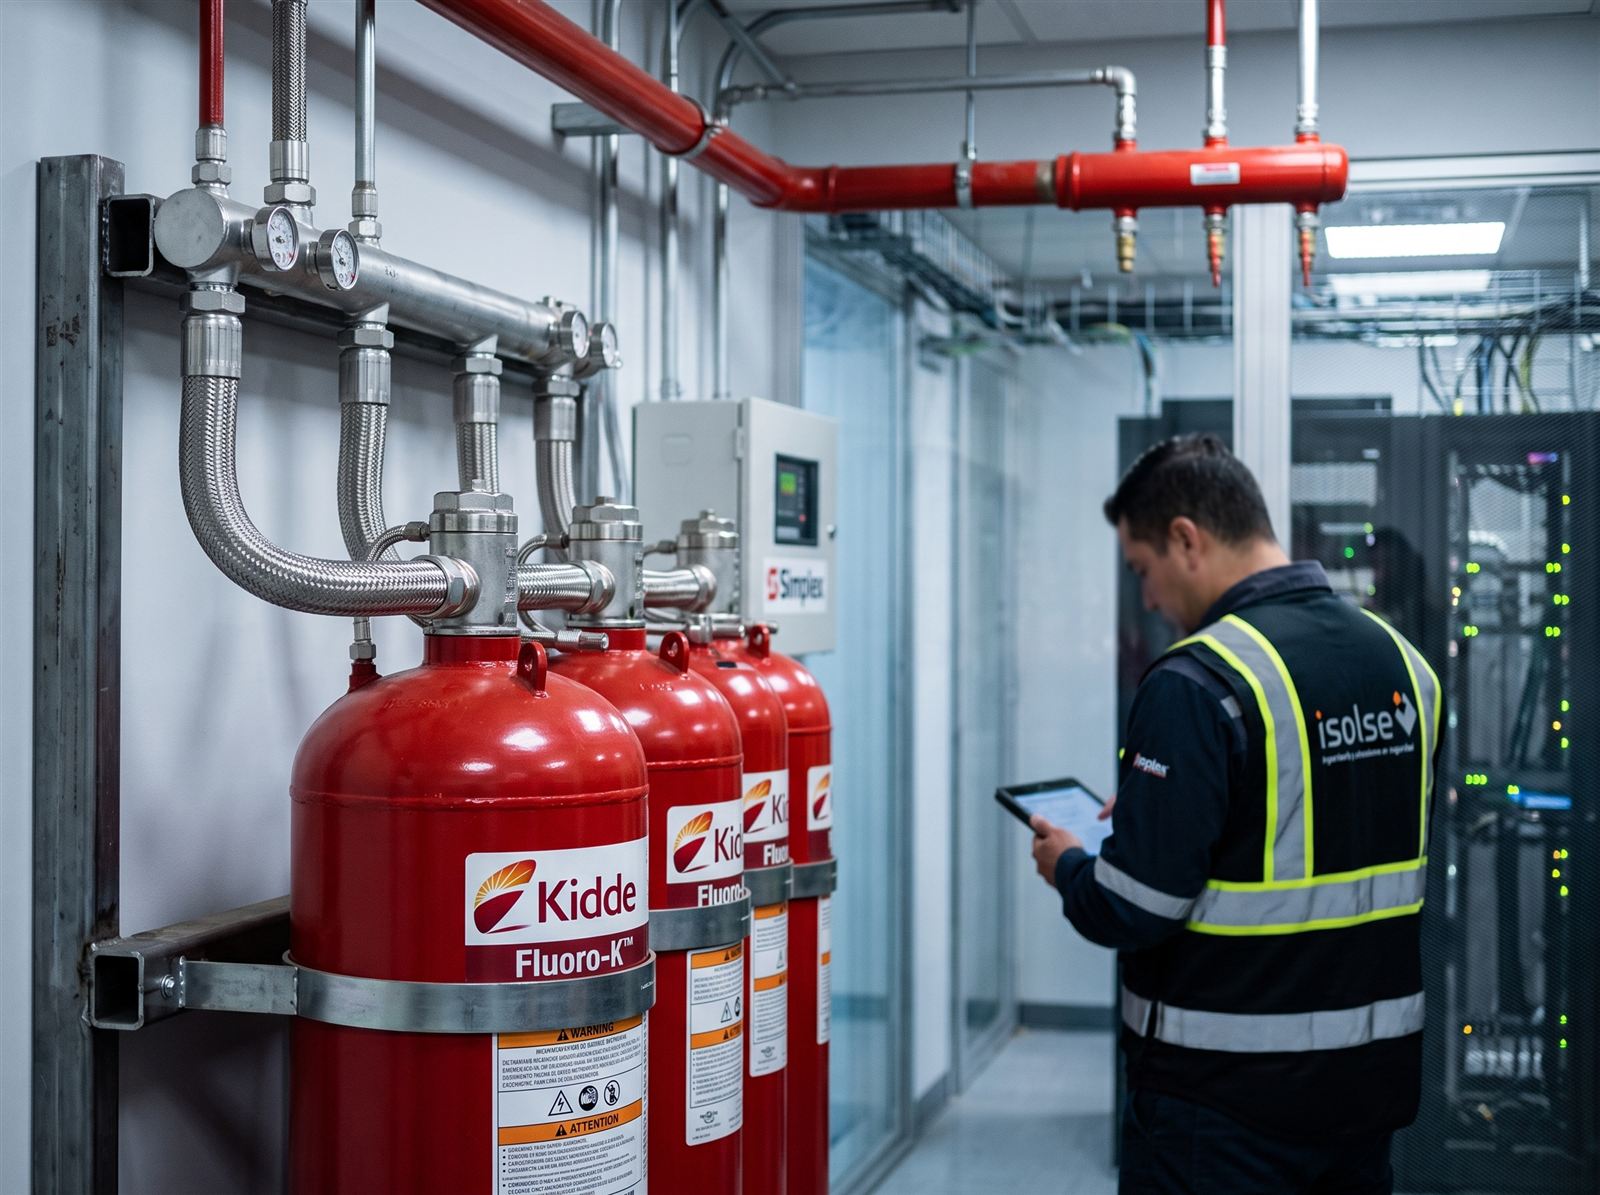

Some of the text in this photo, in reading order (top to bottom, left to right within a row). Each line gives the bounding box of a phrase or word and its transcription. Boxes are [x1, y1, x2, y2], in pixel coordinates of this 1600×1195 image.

[1315, 703, 1394, 750] isolse
[538, 873, 637, 923] Kidde
[570, 1022, 614, 1038] WARNING
[569, 1114, 619, 1134] ATTENTION
